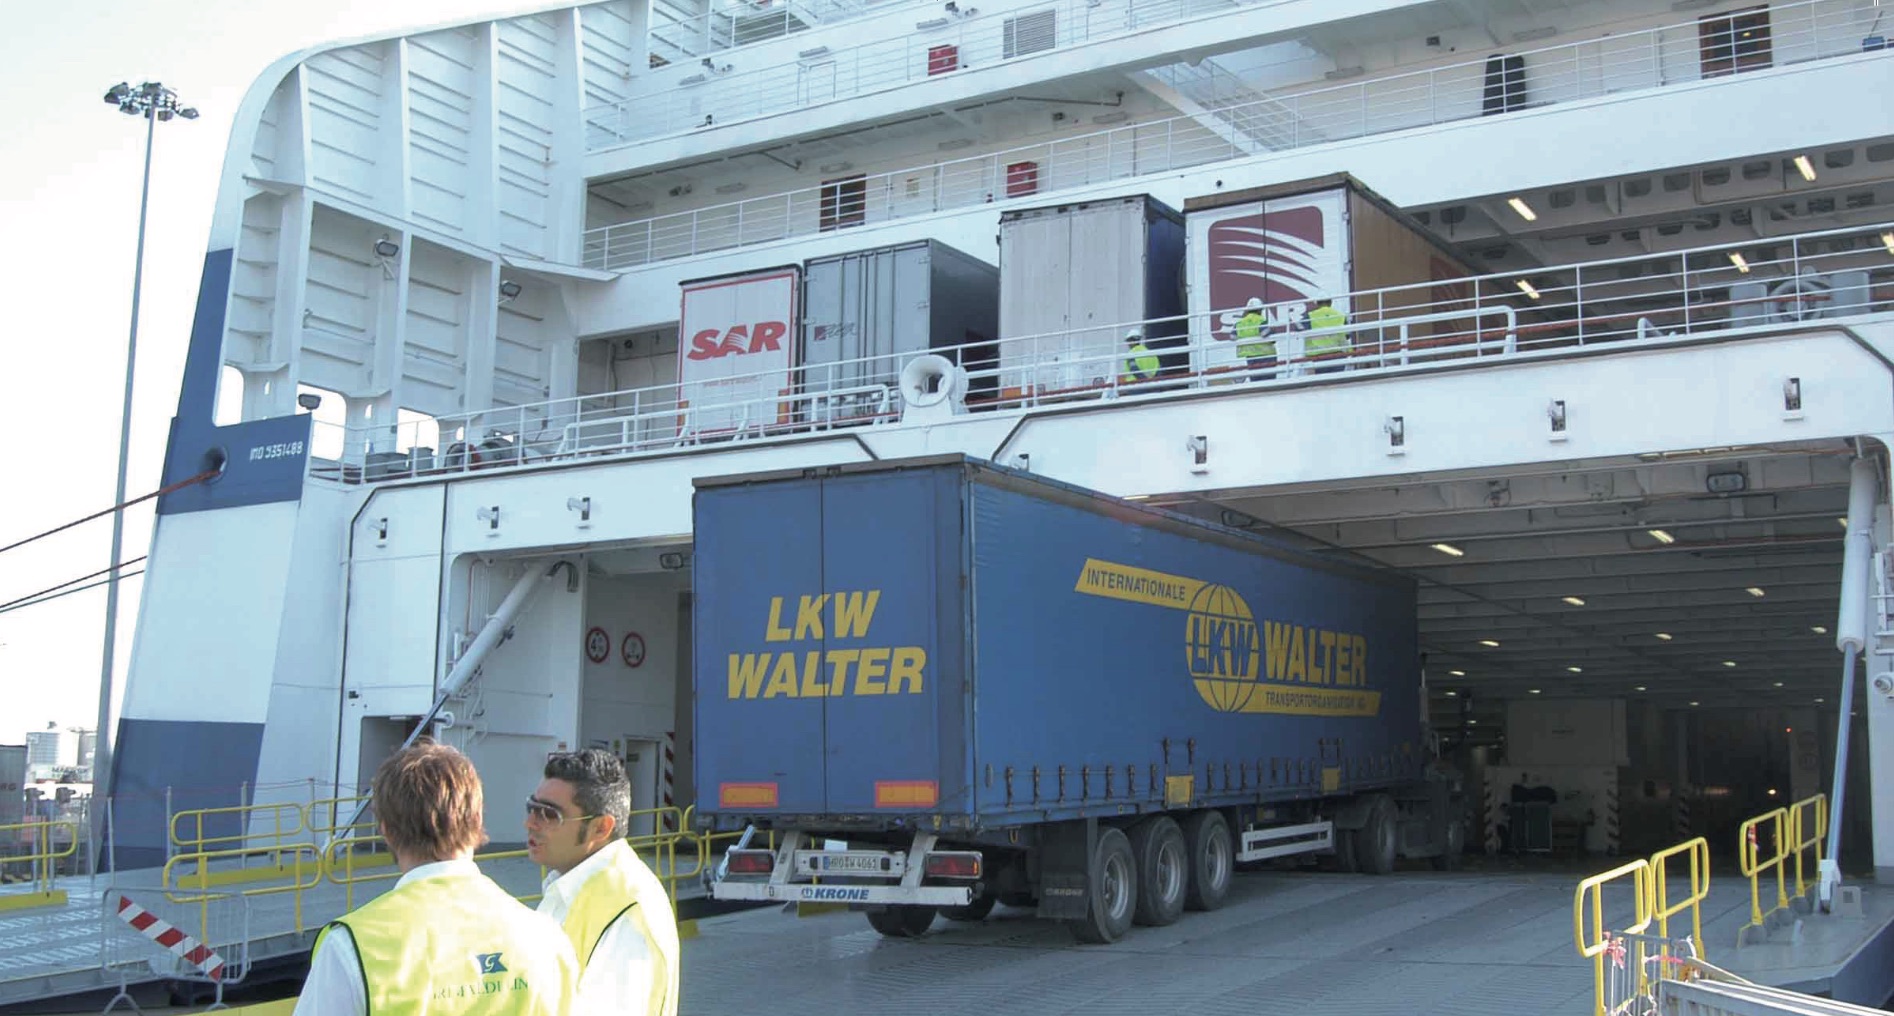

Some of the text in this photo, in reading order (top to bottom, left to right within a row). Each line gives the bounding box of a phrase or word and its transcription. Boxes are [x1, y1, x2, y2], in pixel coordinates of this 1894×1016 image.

[686, 321, 786, 361] SAR
[1086, 567, 1187, 602] INTERNATIONALE
[764, 589, 882, 642] LKW
[727, 646, 927, 699] WALTER
[1190, 616, 1368, 687] LKW WALTER
[814, 888, 870, 900] KRONE
